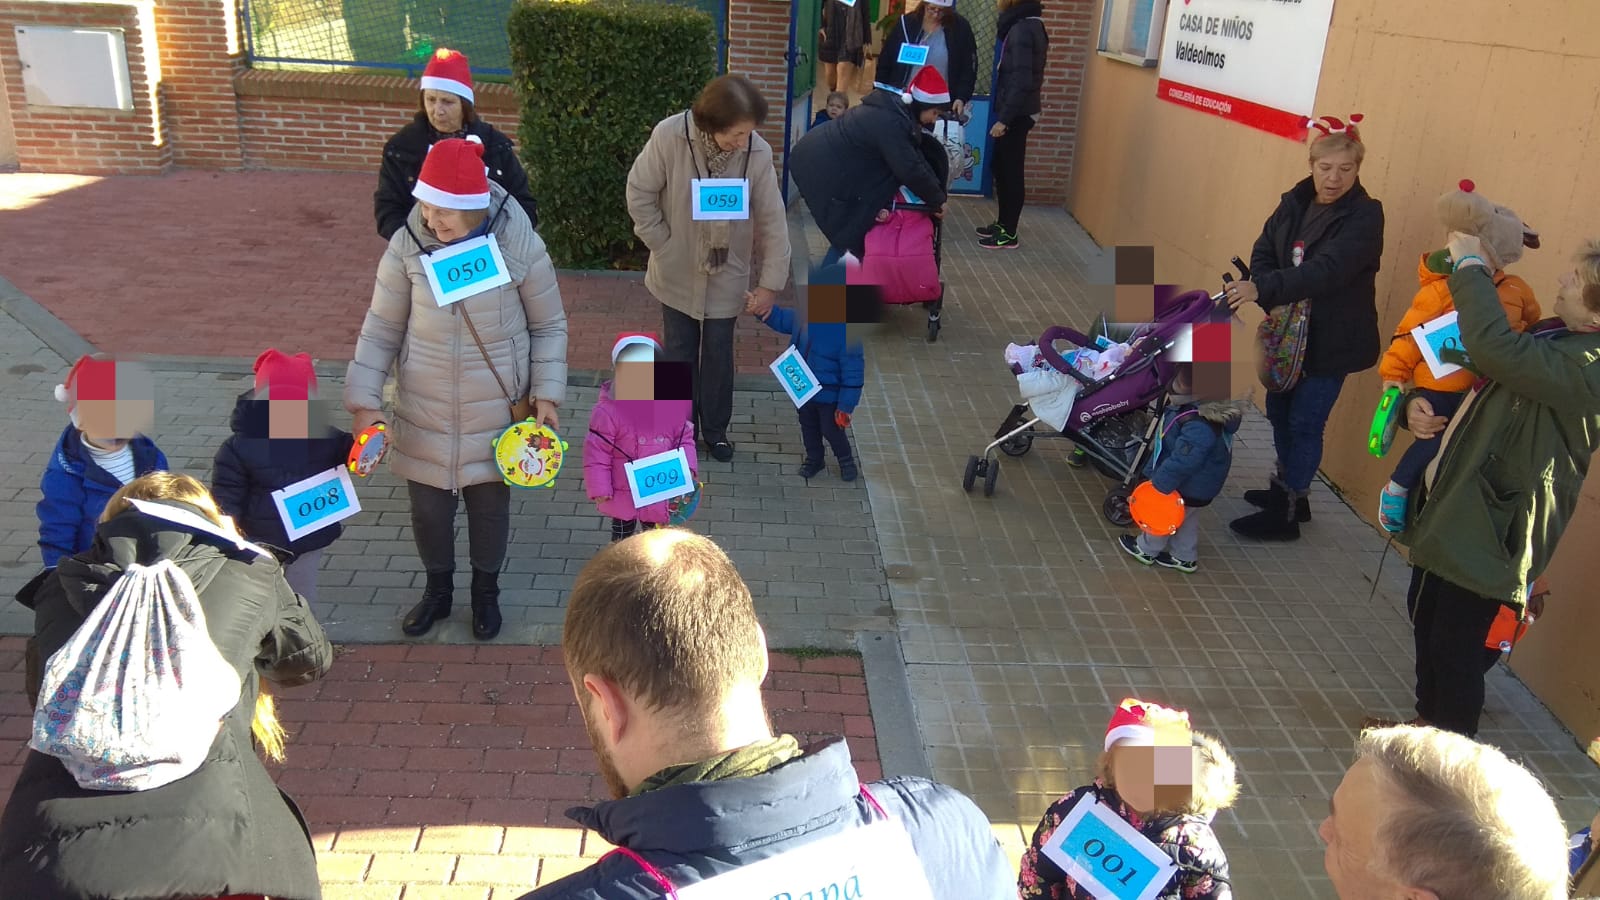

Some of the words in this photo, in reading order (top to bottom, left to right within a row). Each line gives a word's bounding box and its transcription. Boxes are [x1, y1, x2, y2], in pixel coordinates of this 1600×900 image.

[1179, 13, 1203, 33] CASA
[1205, 16, 1220, 36] DE
[1220, 16, 1254, 41] NIÑOS
[1175, 40, 1226, 69] Valdeolmos
[707, 193, 738, 208] 059
[447, 257, 487, 282] 050
[644, 468, 679, 488] 009
[298, 487, 339, 517] 008
[1083, 838, 1138, 886] 001
